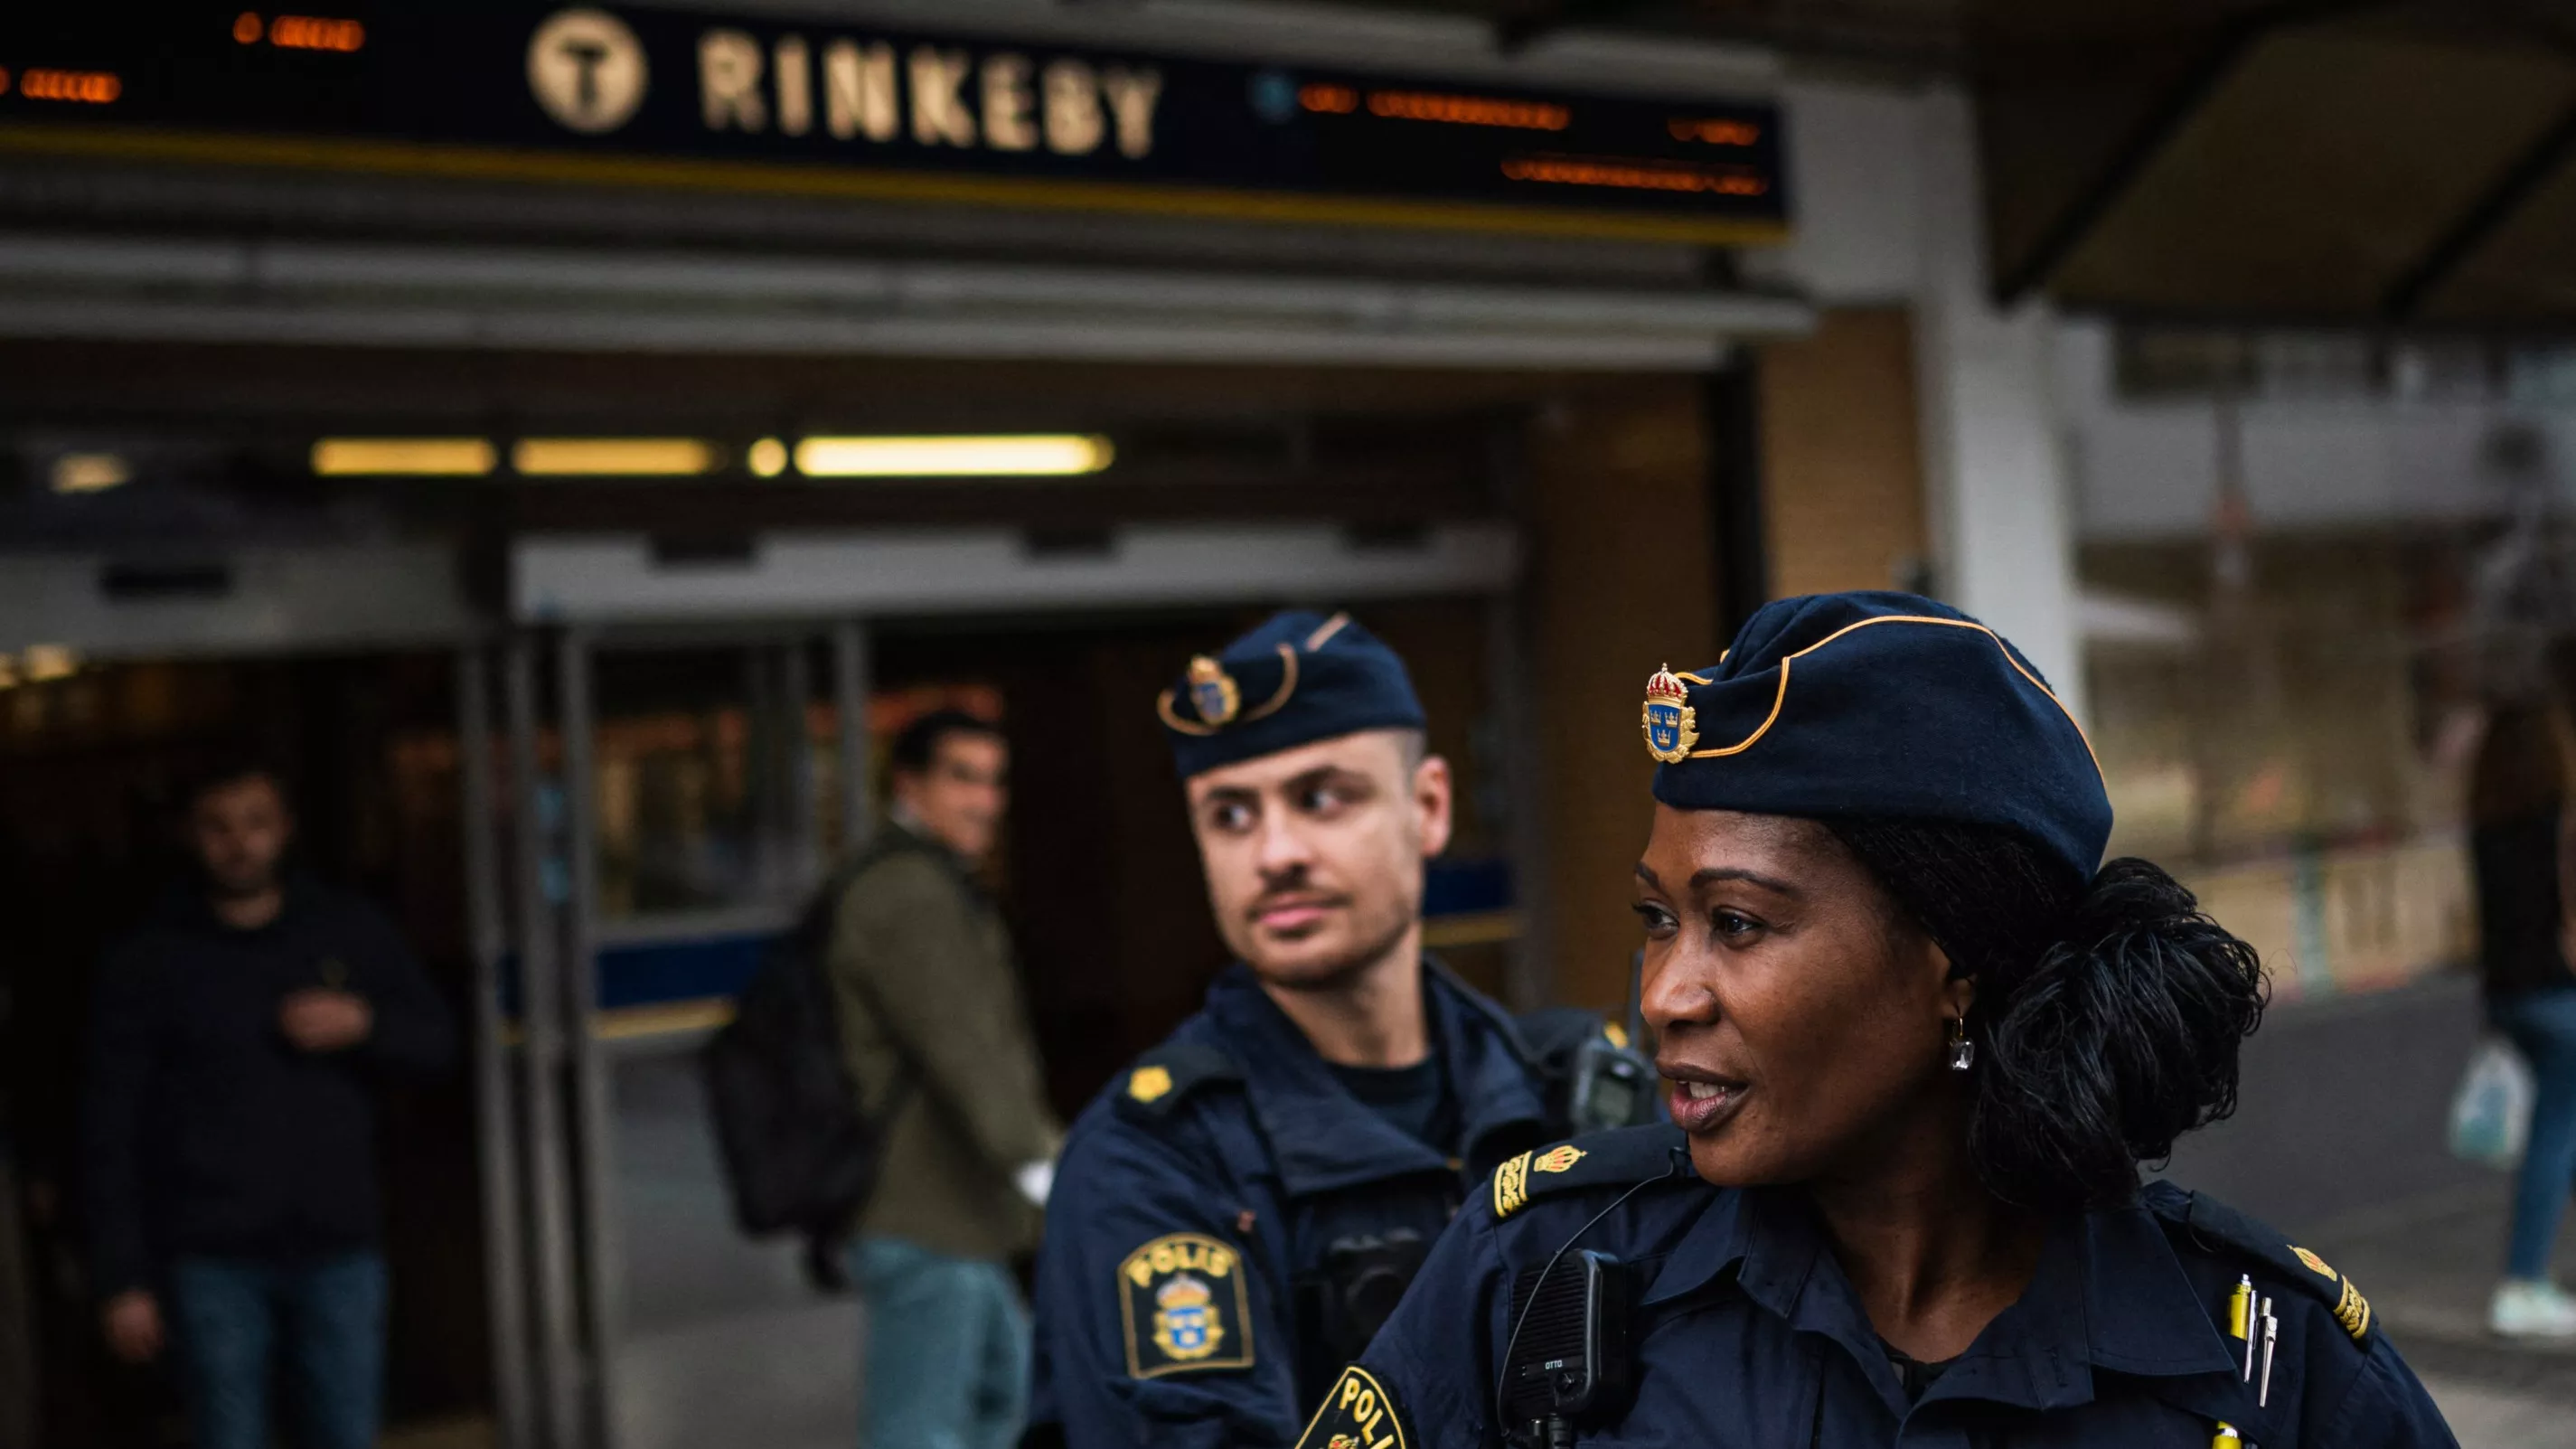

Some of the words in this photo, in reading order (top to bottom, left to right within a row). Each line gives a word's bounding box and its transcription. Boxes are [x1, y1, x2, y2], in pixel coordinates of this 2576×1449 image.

[698, 29, 1162, 159] RINKEBY
[1124, 1243, 1232, 1288] POLIS
[1545, 1360, 1563, 1369] OTTO
